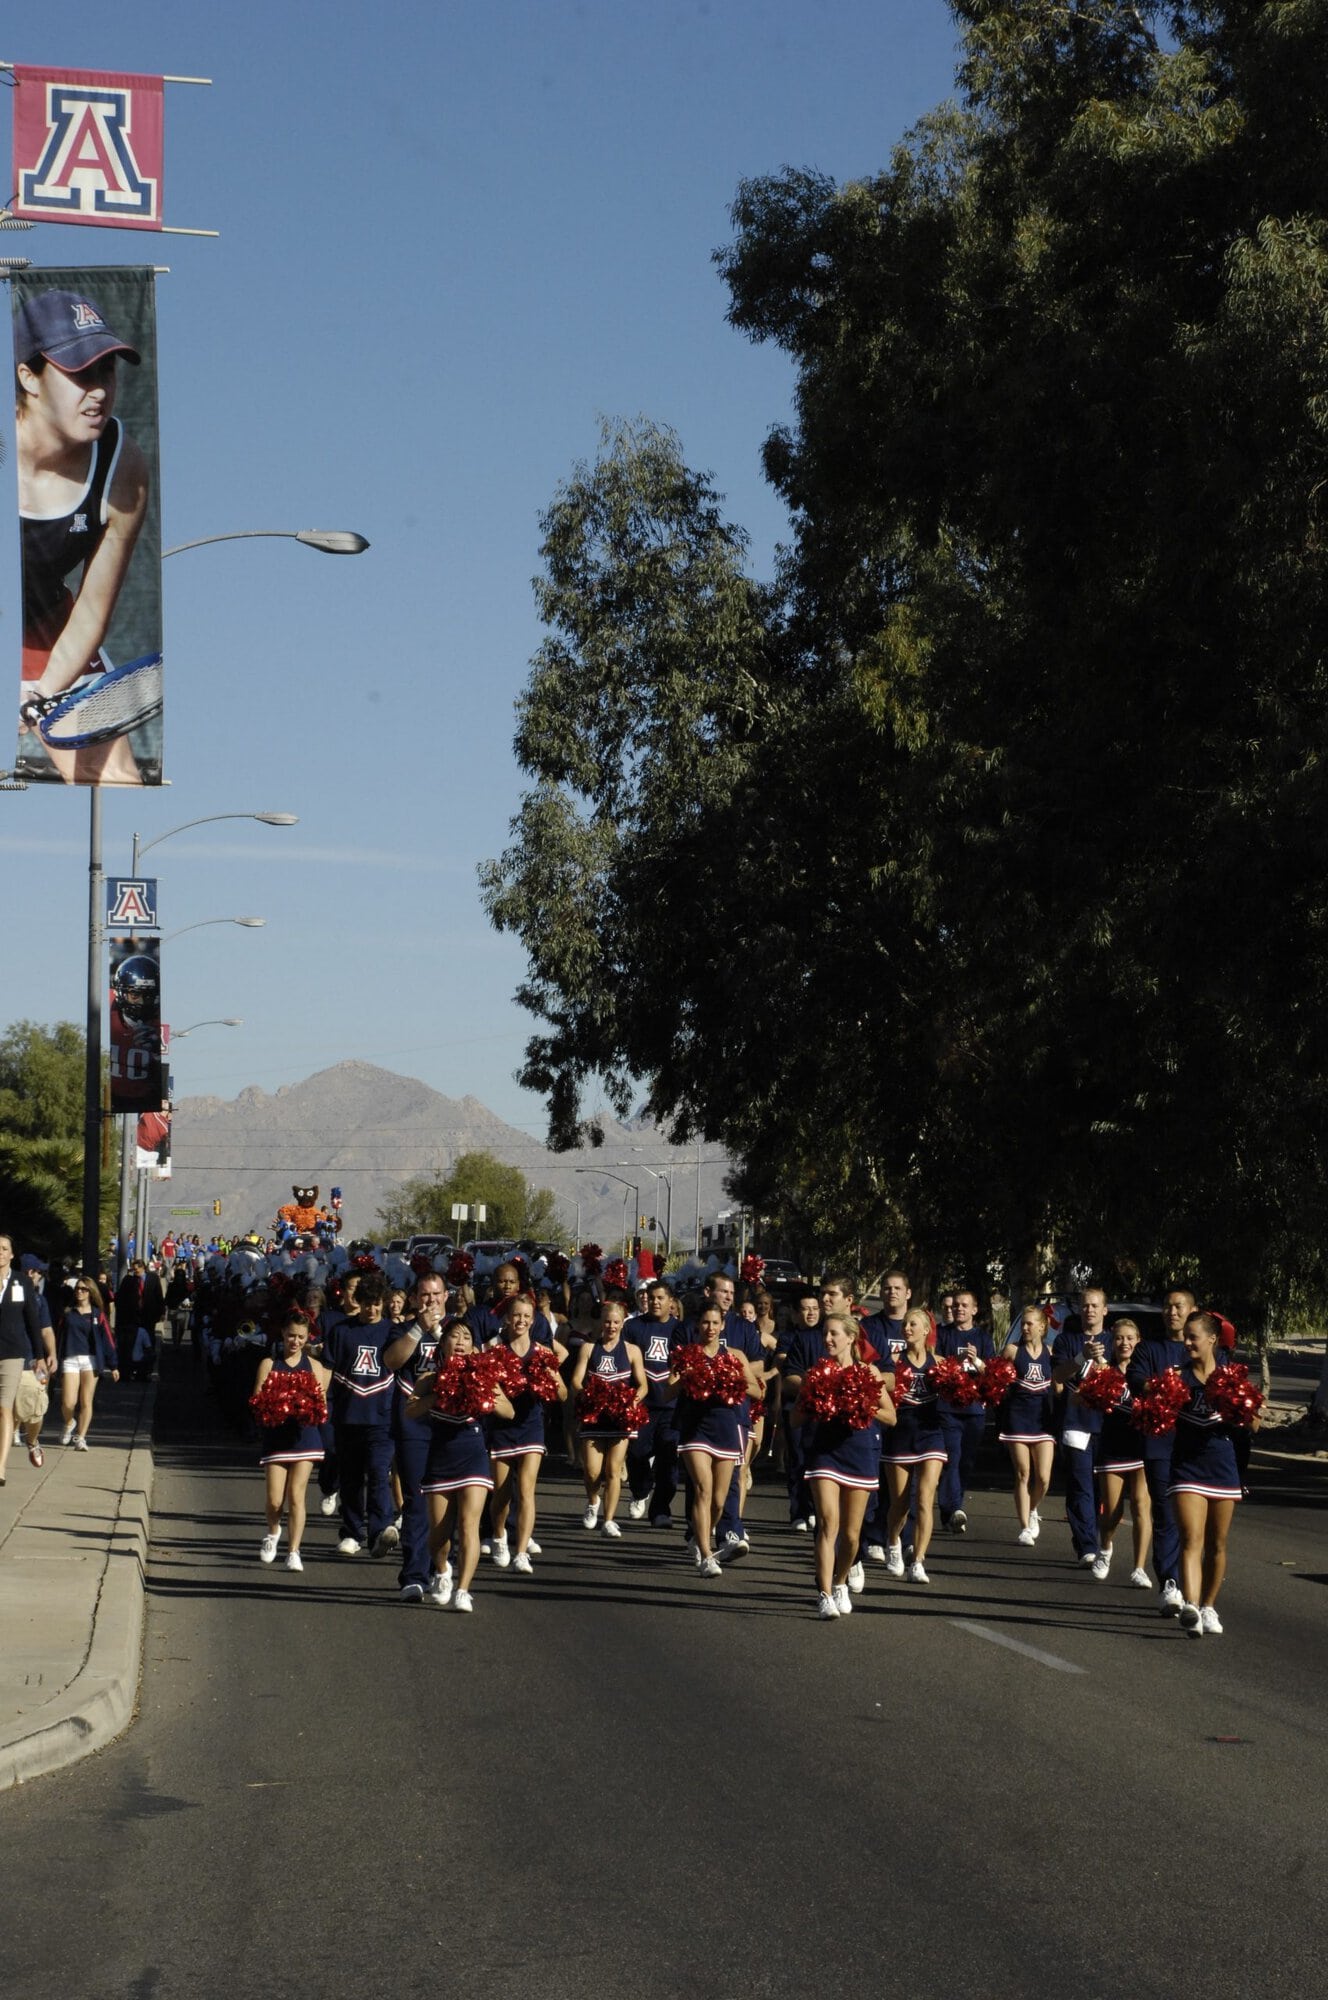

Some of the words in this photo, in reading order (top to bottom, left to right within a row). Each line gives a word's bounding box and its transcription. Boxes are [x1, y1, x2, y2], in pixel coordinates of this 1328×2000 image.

[18, 82, 157, 221] A
[108, 882, 156, 927] A
[351, 1345, 381, 1376] A
[645, 1335, 669, 1363] A
[597, 1355, 617, 1375] A
[1025, 1362, 1045, 1382] A
